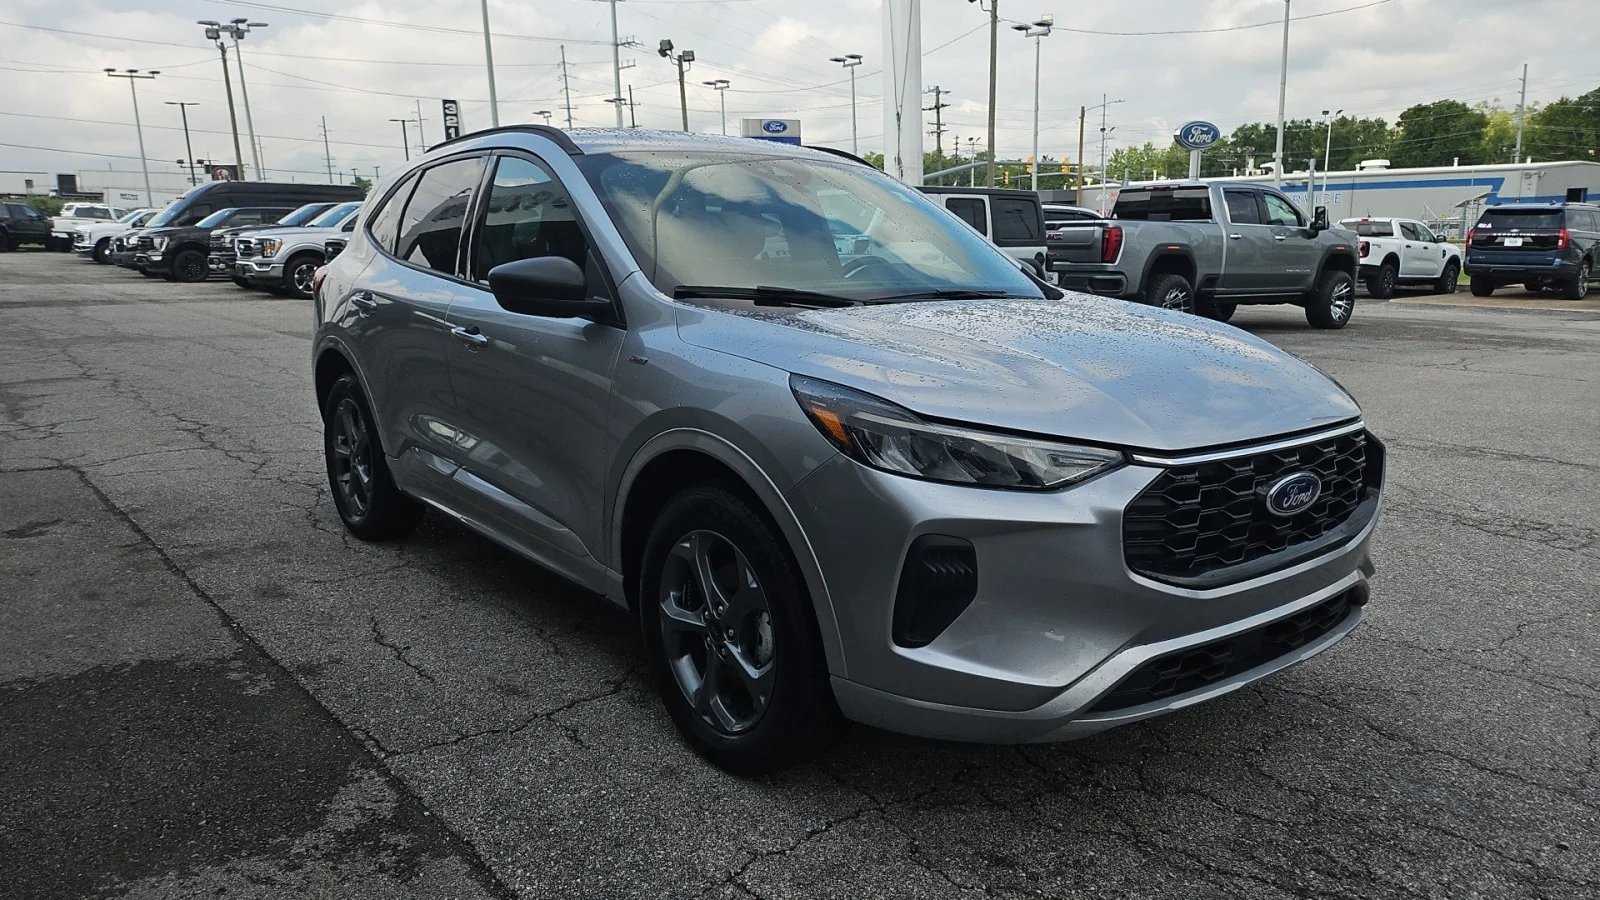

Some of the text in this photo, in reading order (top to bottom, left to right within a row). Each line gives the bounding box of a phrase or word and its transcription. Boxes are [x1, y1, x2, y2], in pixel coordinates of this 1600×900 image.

[444, 103, 458, 138] 321
[1188, 126, 1214, 143] Ford
[1293, 193, 1342, 204] RVICE
[1282, 481, 1313, 508] Ford
